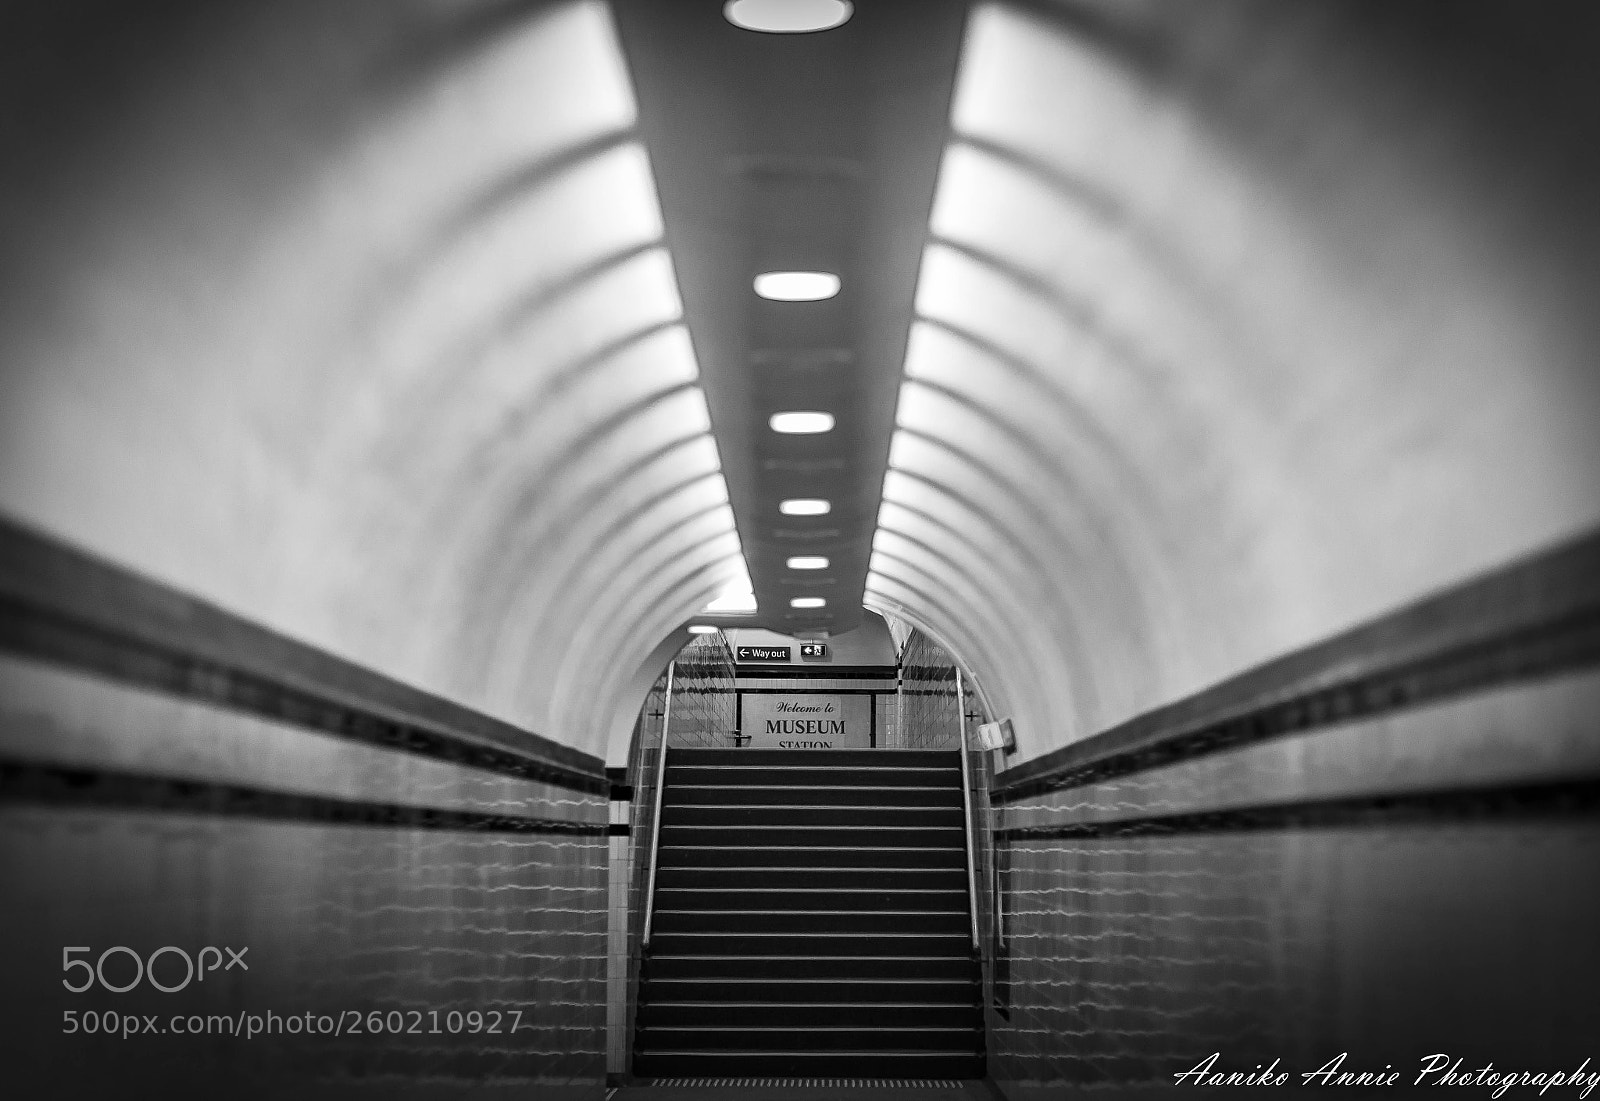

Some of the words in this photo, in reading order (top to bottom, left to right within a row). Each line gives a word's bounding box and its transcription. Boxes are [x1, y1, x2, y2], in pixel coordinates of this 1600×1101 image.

[752, 649, 770, 659] Way
[771, 650, 786, 658] out
[776, 701, 822, 713] Welcome
[824, 702, 834, 713] to
[766, 720, 846, 734] MUSEUM
[779, 741, 833, 749] STATION
